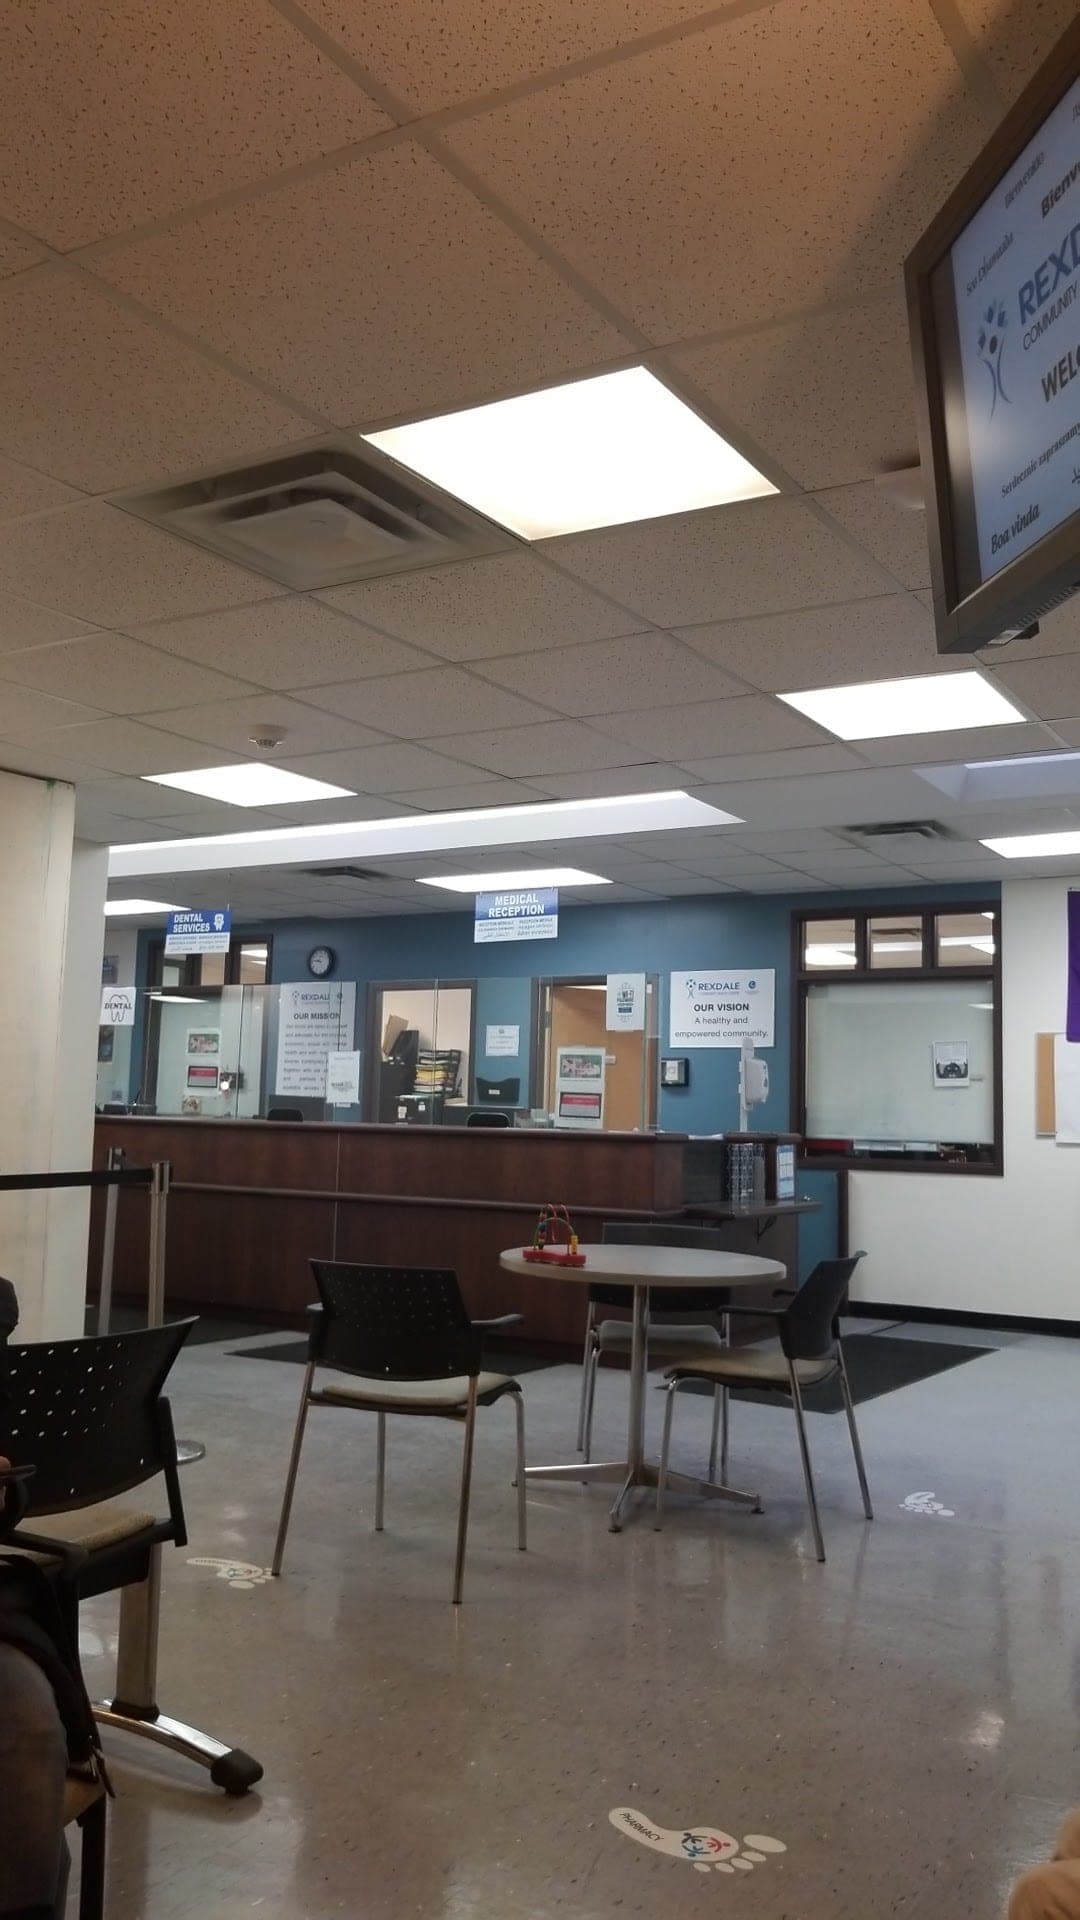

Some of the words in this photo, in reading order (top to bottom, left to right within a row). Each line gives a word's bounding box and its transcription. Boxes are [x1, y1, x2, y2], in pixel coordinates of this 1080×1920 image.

[1023, 280, 1078, 350] COMMUNITY
[991, 529, 1010, 554] Boa
[1010, 504, 1040, 537] vinda
[494, 893, 539, 906] MEDICAL
[488, 904, 545, 918] RECEPTION
[173, 913, 204, 923] DENTAL
[172, 923, 210, 933] SERVICES
[698, 982, 740, 991] REXDALE
[104, 1002, 133, 1010] DENTAL
[694, 1003, 714, 1012] OUR
[717, 1003, 749, 1012] VISION
[293, 1012, 309, 1020] OUR
[702, 1016, 731, 1025] healthy
[733, 1016, 748, 1024] and
[675, 1030, 720, 1038] empowered
[722, 1029, 769, 1038] community.
[619, 1812, 664, 1841] PHARMACY
